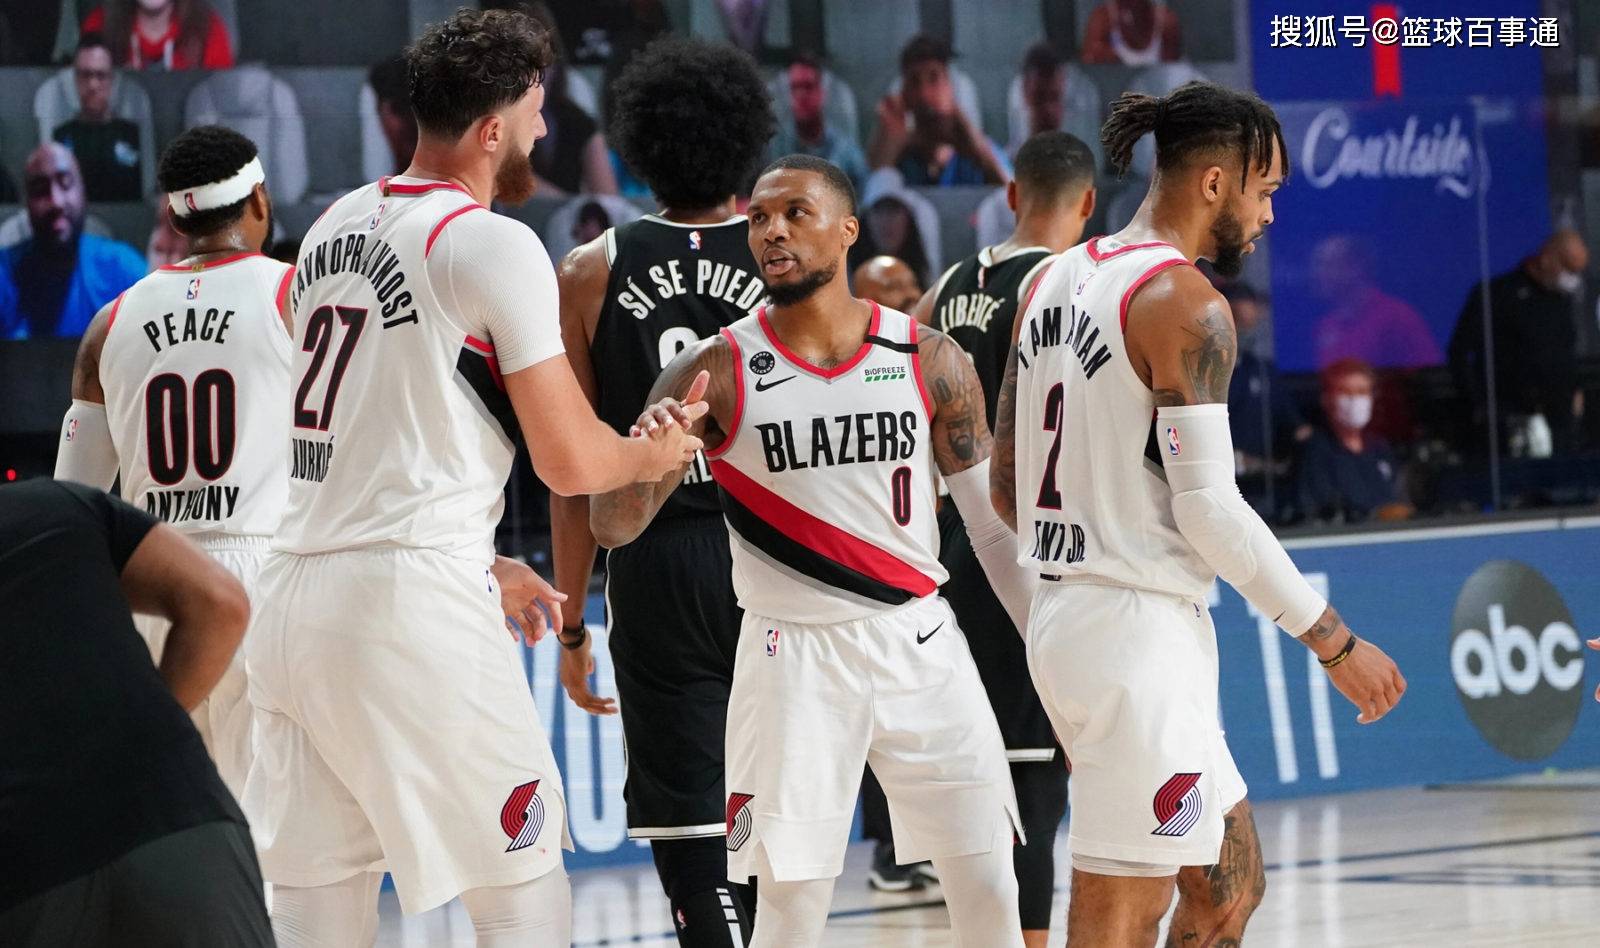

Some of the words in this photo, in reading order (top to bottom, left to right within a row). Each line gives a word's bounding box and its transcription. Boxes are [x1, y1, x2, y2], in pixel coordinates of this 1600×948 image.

[649, 259, 687, 299] SE
[143, 308, 235, 353] PEACE
[1030, 306, 1062, 357] AM
[1071, 310, 1113, 381] MAN
[294, 304, 368, 432] 27
[145, 368, 236, 486] 00
[754, 410, 917, 473] BLAZERS
[1036, 381, 1064, 511] 2
[146, 485, 239, 523] ANTHONY
[891, 465, 912, 527] 0
[1450, 604, 1585, 699] abc
